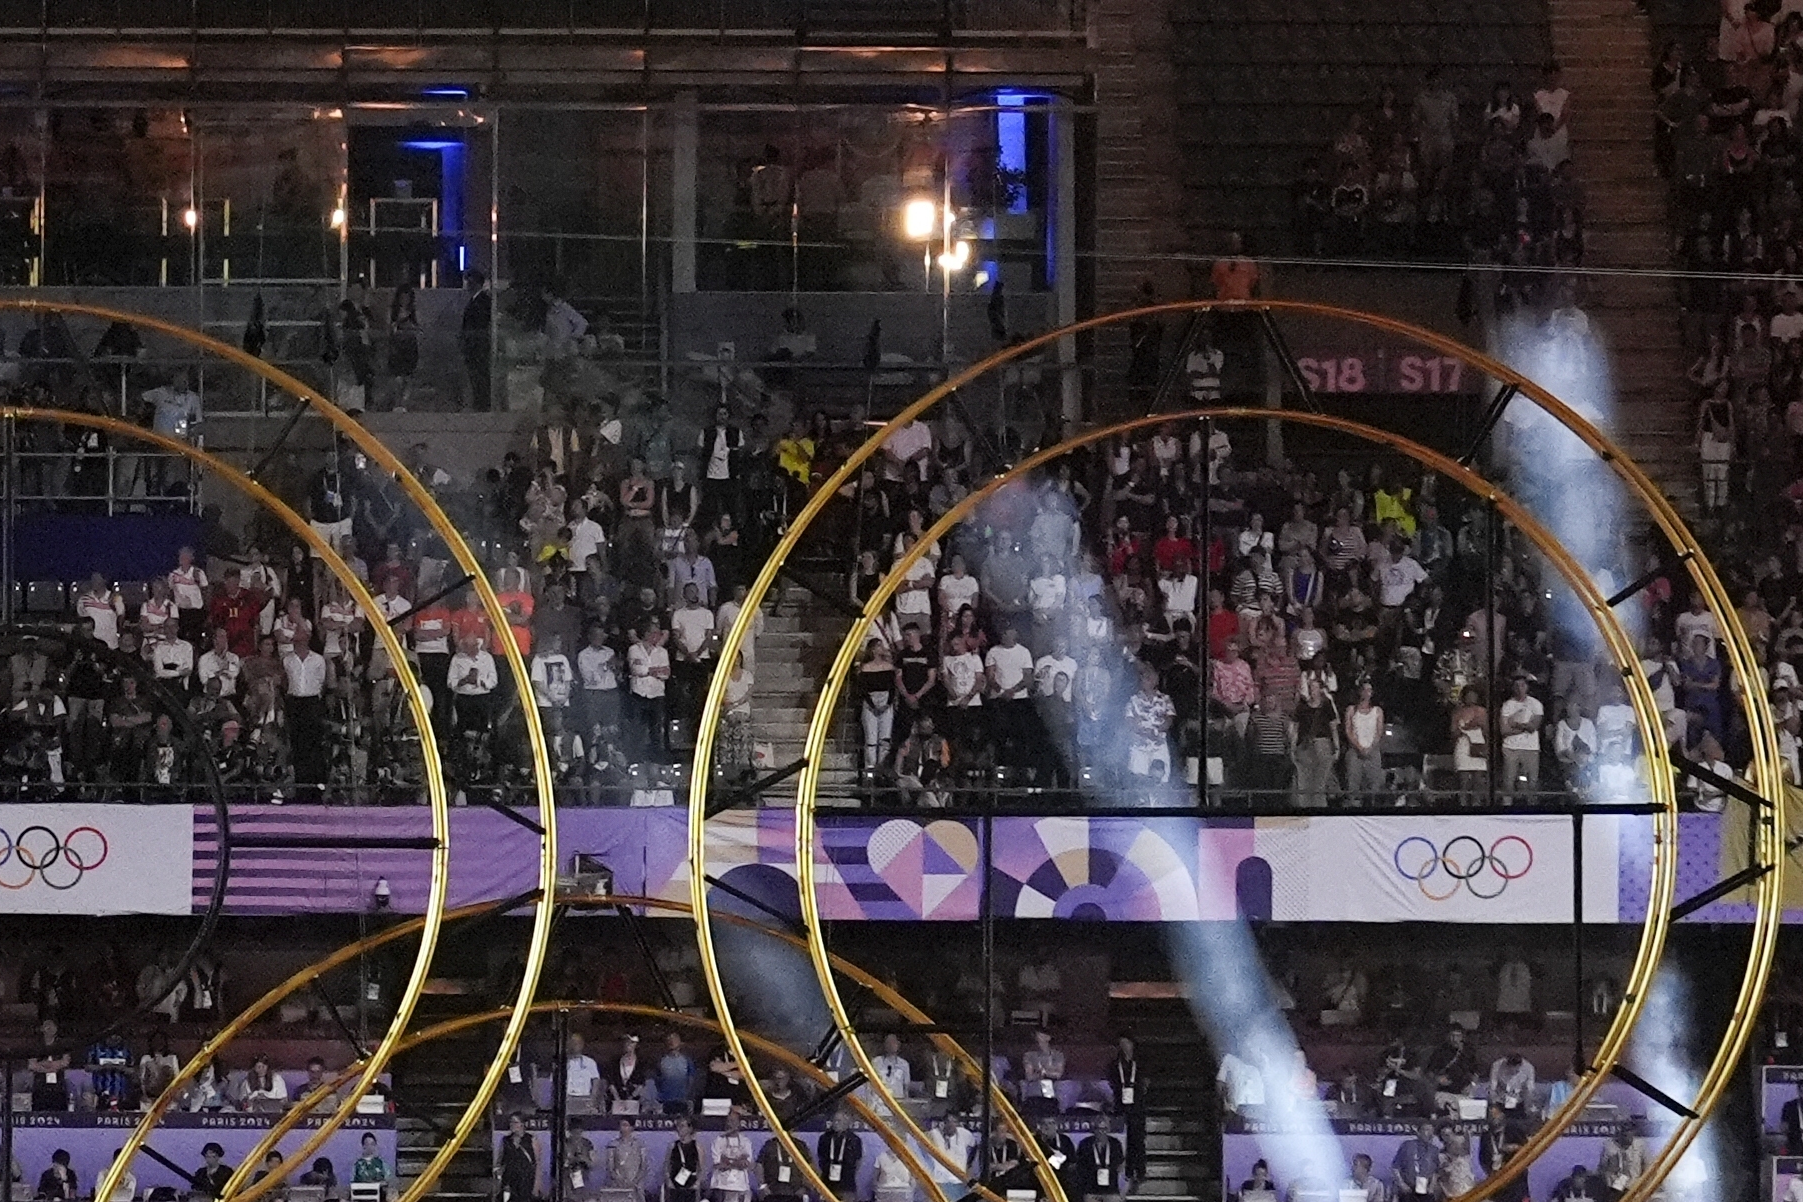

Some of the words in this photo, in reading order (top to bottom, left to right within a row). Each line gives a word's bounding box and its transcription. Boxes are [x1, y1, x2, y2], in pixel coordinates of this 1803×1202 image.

[1298, 358, 1365, 392] S18
[1401, 356, 1463, 392] S17
[30, 1114, 61, 1125] 2024
[97, 1115, 130, 1126] PARIS
[202, 1115, 236, 1126] PARIS
[240, 1115, 271, 1126] 2024
